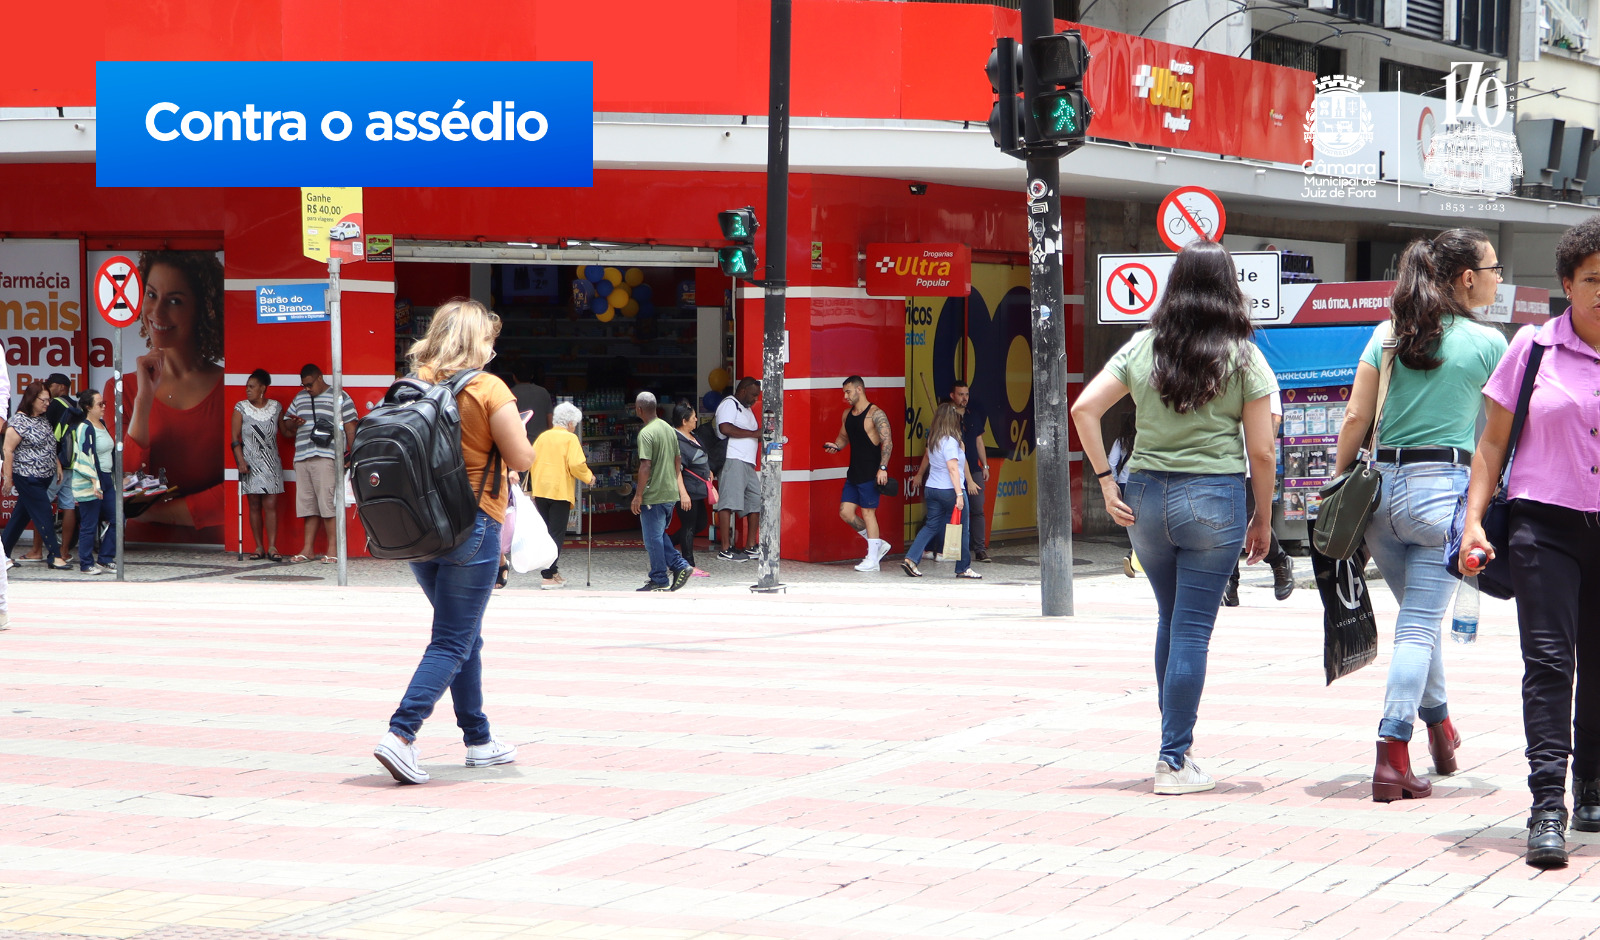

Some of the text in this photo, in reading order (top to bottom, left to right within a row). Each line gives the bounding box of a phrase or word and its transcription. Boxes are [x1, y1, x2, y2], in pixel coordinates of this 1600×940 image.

[306, 192, 332, 203] Ganhe
[307, 204, 318, 214] R$
[923, 250, 954, 259] Drogarias
[895, 256, 951, 276] Ultra
[916, 278, 950, 288] Popular
[260, 287, 276, 296] Av.
[260, 295, 303, 305] Barão do
[1252, 297, 1271, 309] es
[1312, 299, 1328, 310] SUA
[1328, 296, 1351, 311] ÓTICA,
[1352, 298, 1359, 309] A
[1359, 297, 1382, 310] PREÇO
[0, 291, 81, 331] mais
[260, 304, 313, 314] Rio Branco
[0, 330, 114, 368] arata
[1276, 368, 1354, 381] ARREGUE AGORA
[1306, 392, 1328, 402] vivo
[997, 477, 1028, 498] sconto
